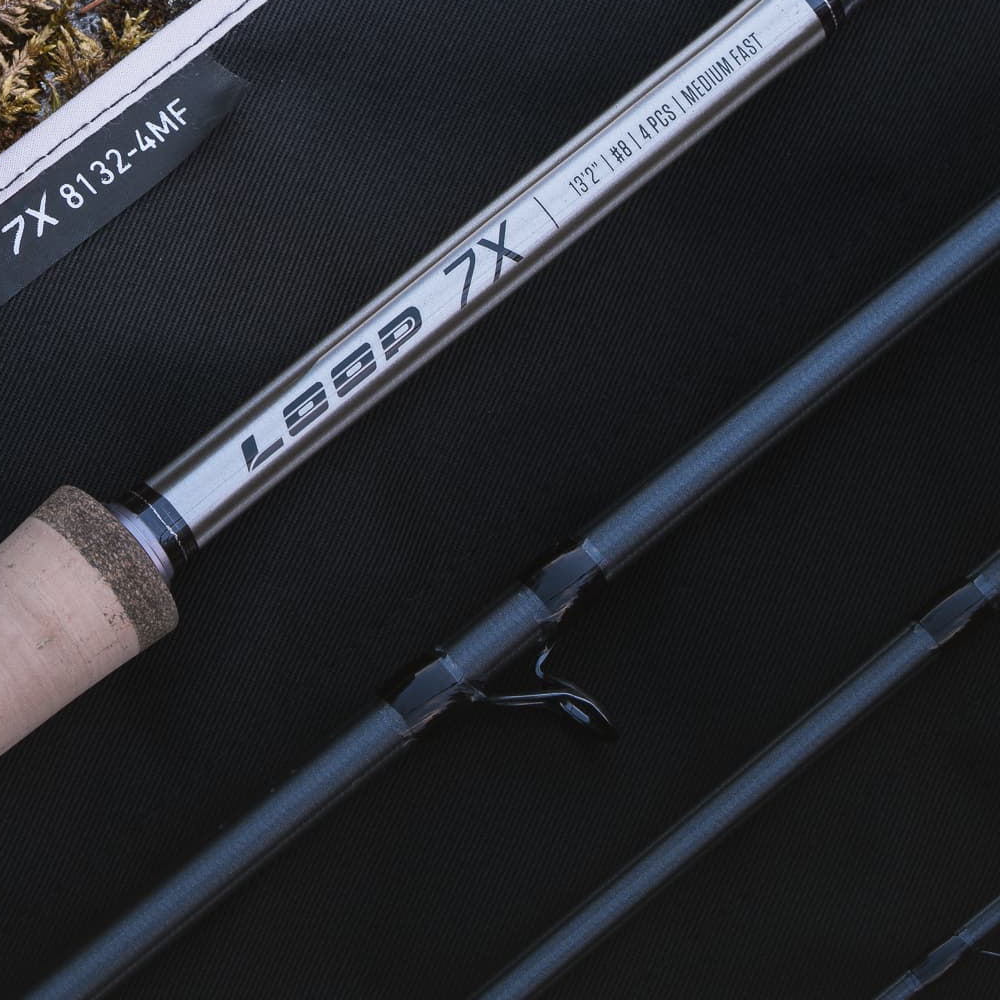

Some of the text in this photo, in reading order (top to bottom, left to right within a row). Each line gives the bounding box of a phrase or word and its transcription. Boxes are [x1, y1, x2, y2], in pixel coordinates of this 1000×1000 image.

[1, 189, 59, 256] 7X
[59, 97, 189, 209] 8132-4MF
[609, 139, 633, 164] #8
[637, 123, 652, 141] 4
[646, 103, 677, 134] PCS
[680, 56, 735, 106] MEDIUM
[729, 32, 764, 66] FAST
[241, 219, 524, 473] LOOP 7X
